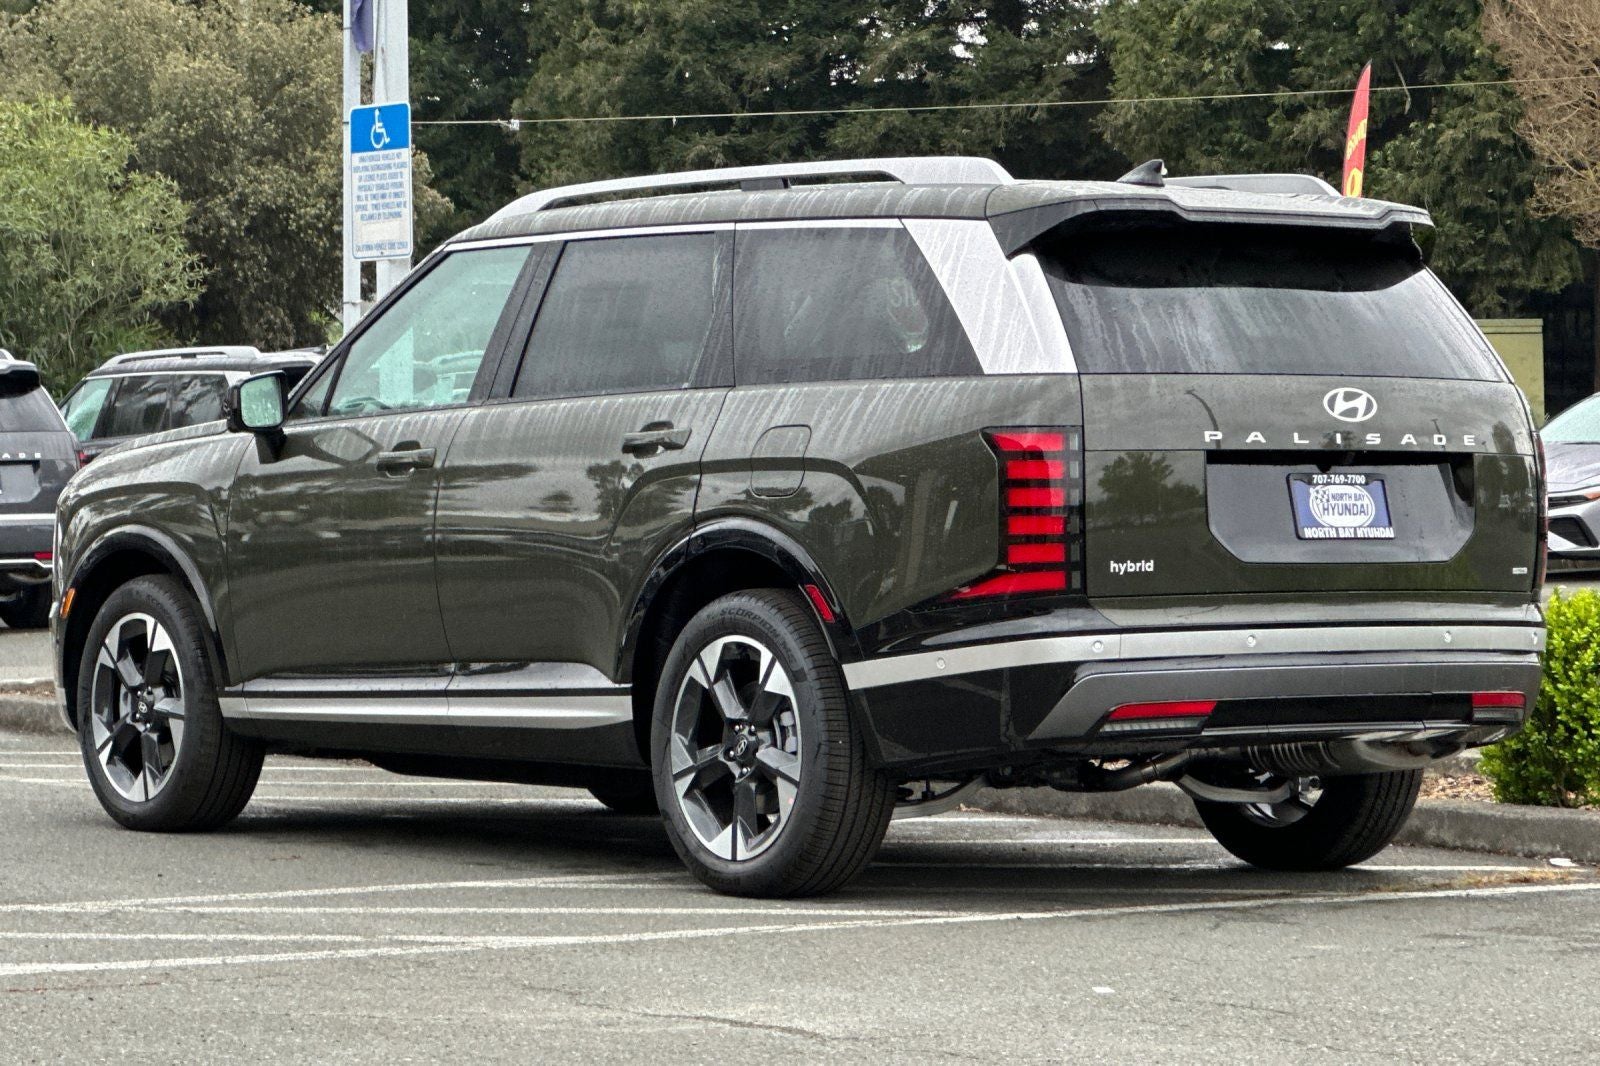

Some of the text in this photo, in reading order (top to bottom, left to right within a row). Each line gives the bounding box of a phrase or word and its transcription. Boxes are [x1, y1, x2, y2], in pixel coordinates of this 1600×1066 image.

[1204, 430, 1476, 447] PALISADE
[1312, 474, 1366, 484] 707-769-7700
[1331, 492, 1366, 502] NORTH BAY
[1322, 503, 1369, 516] HYUNDAI
[1303, 526, 1395, 539] NORTH BAY HYUNDAI
[1110, 559, 1154, 576] hybrid
